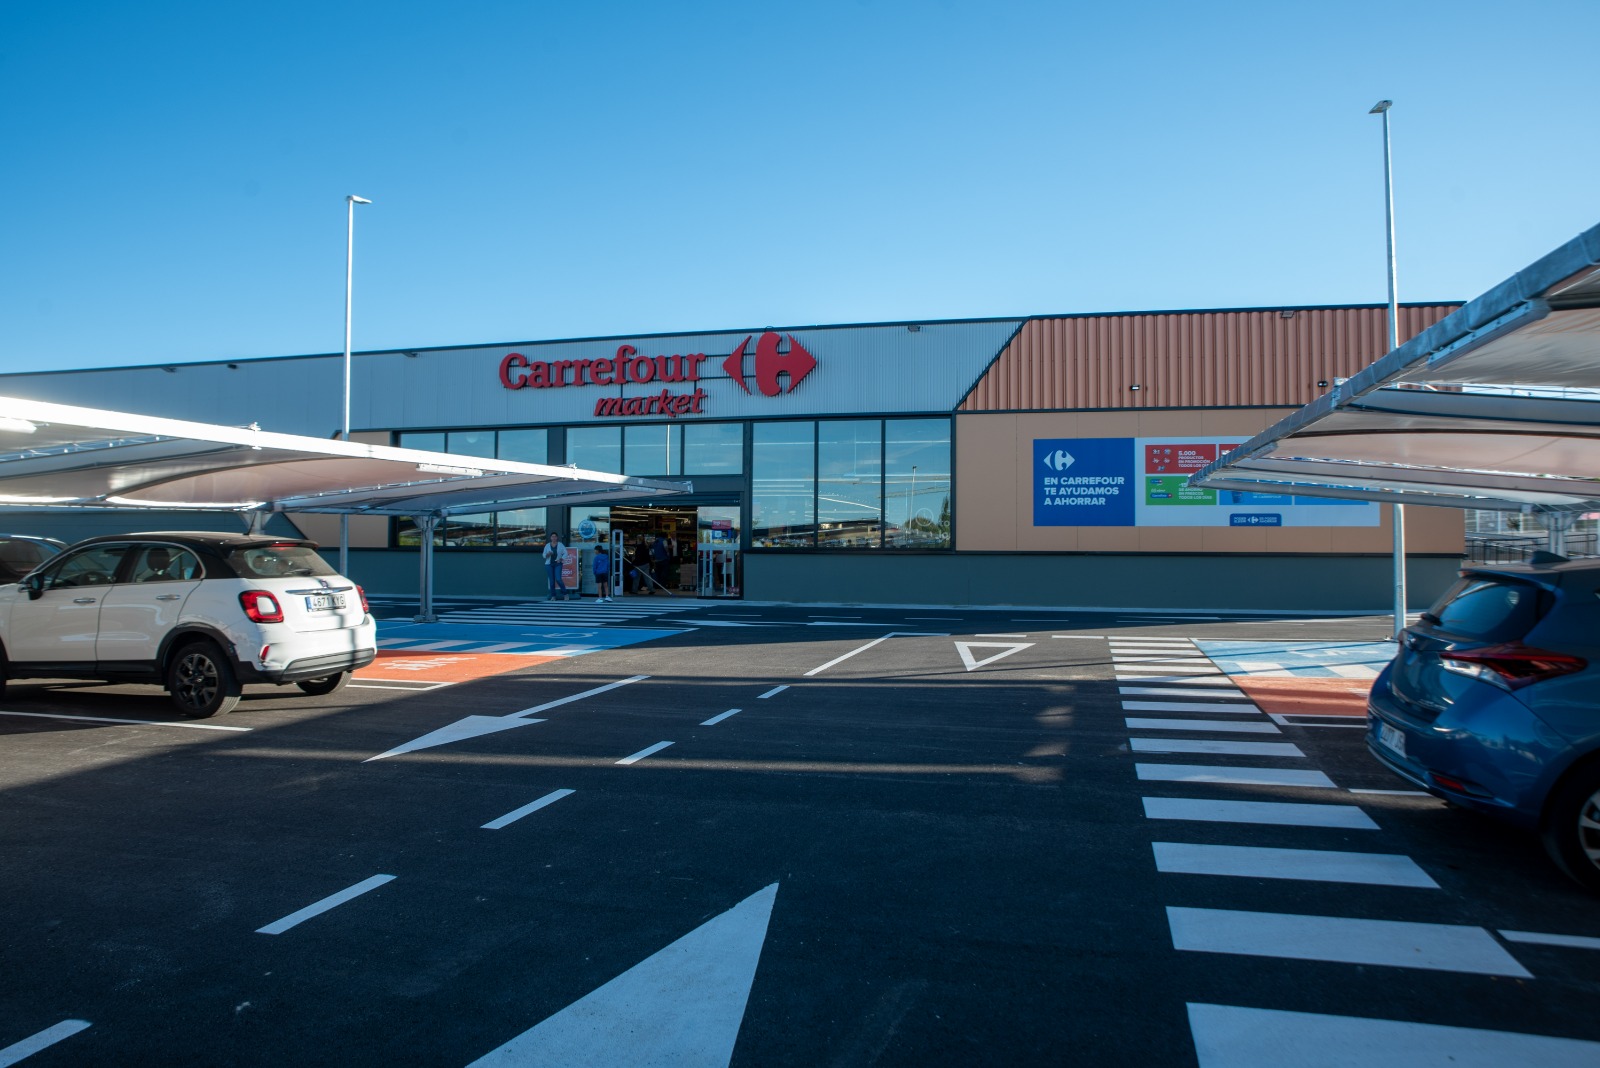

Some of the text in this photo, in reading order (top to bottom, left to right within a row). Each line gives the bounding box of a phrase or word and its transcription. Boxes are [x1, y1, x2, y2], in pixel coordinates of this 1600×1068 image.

[499, 344, 706, 390] Carrefour
[593, 387, 707, 417] market
[1044, 476, 1125, 485] EN CARREFOUR
[1044, 486, 1120, 495] TE AYUDAMOS
[1043, 497, 1106, 506] A AHORRAR
